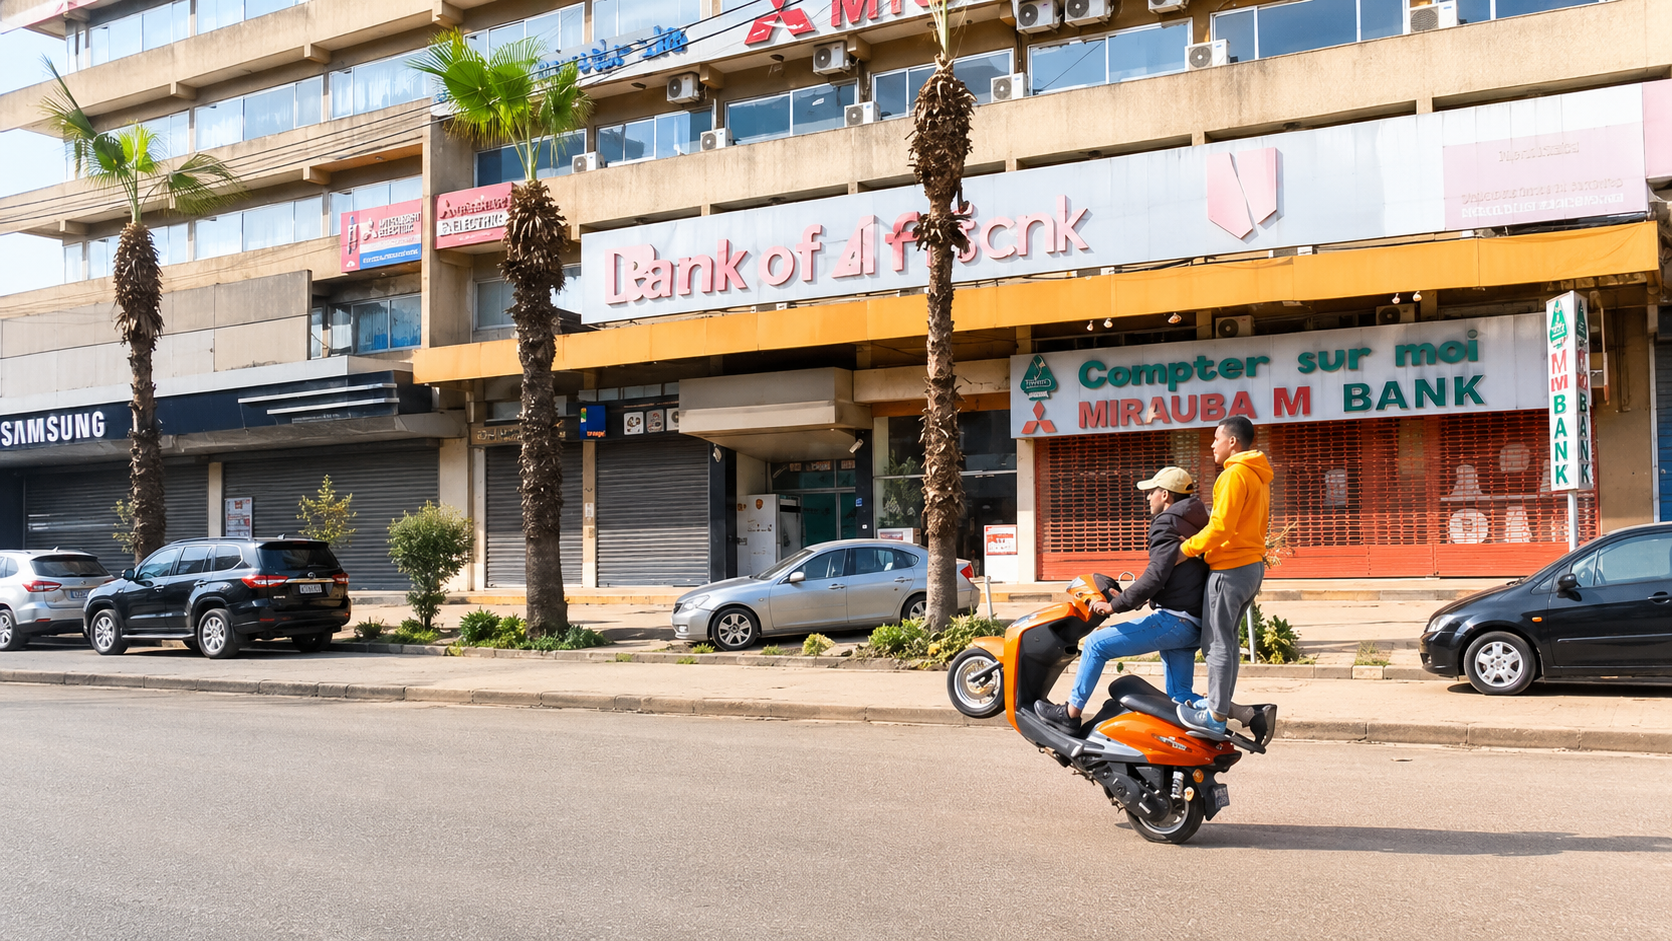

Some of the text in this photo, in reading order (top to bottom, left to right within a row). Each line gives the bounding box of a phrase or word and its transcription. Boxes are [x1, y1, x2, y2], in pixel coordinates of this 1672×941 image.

[758, 223, 823, 286] of
[1078, 329, 1479, 392] Compter sur moi
[0, 411, 105, 446] SAMSUNG
[1078, 374, 1486, 429] MIRAUBA M BANK
[1554, 394, 1569, 485] BANK
